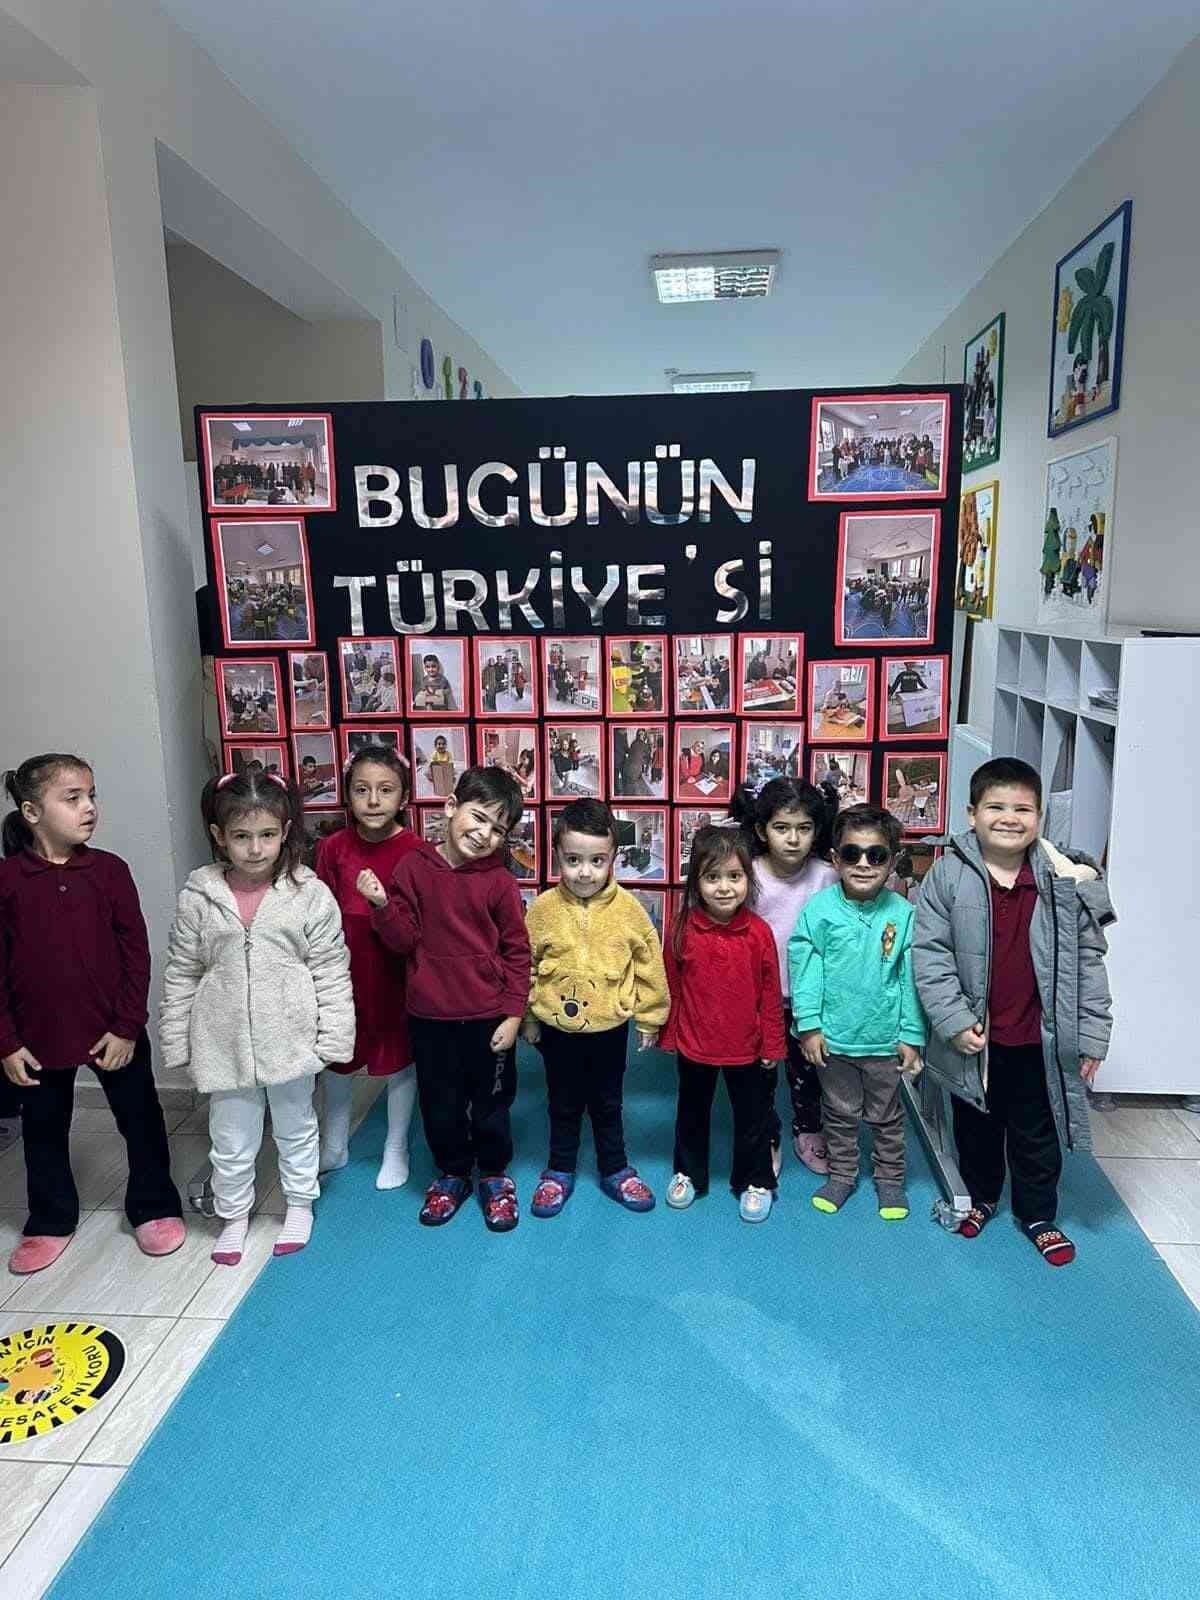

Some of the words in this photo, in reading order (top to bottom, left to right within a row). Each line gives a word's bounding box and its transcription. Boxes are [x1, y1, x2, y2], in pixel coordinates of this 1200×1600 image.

[353, 443, 757, 529] BUGÜNÜN
[0, 1382, 92, 1428] ESAFENİ
[81, 1345, 103, 1379] KORU
